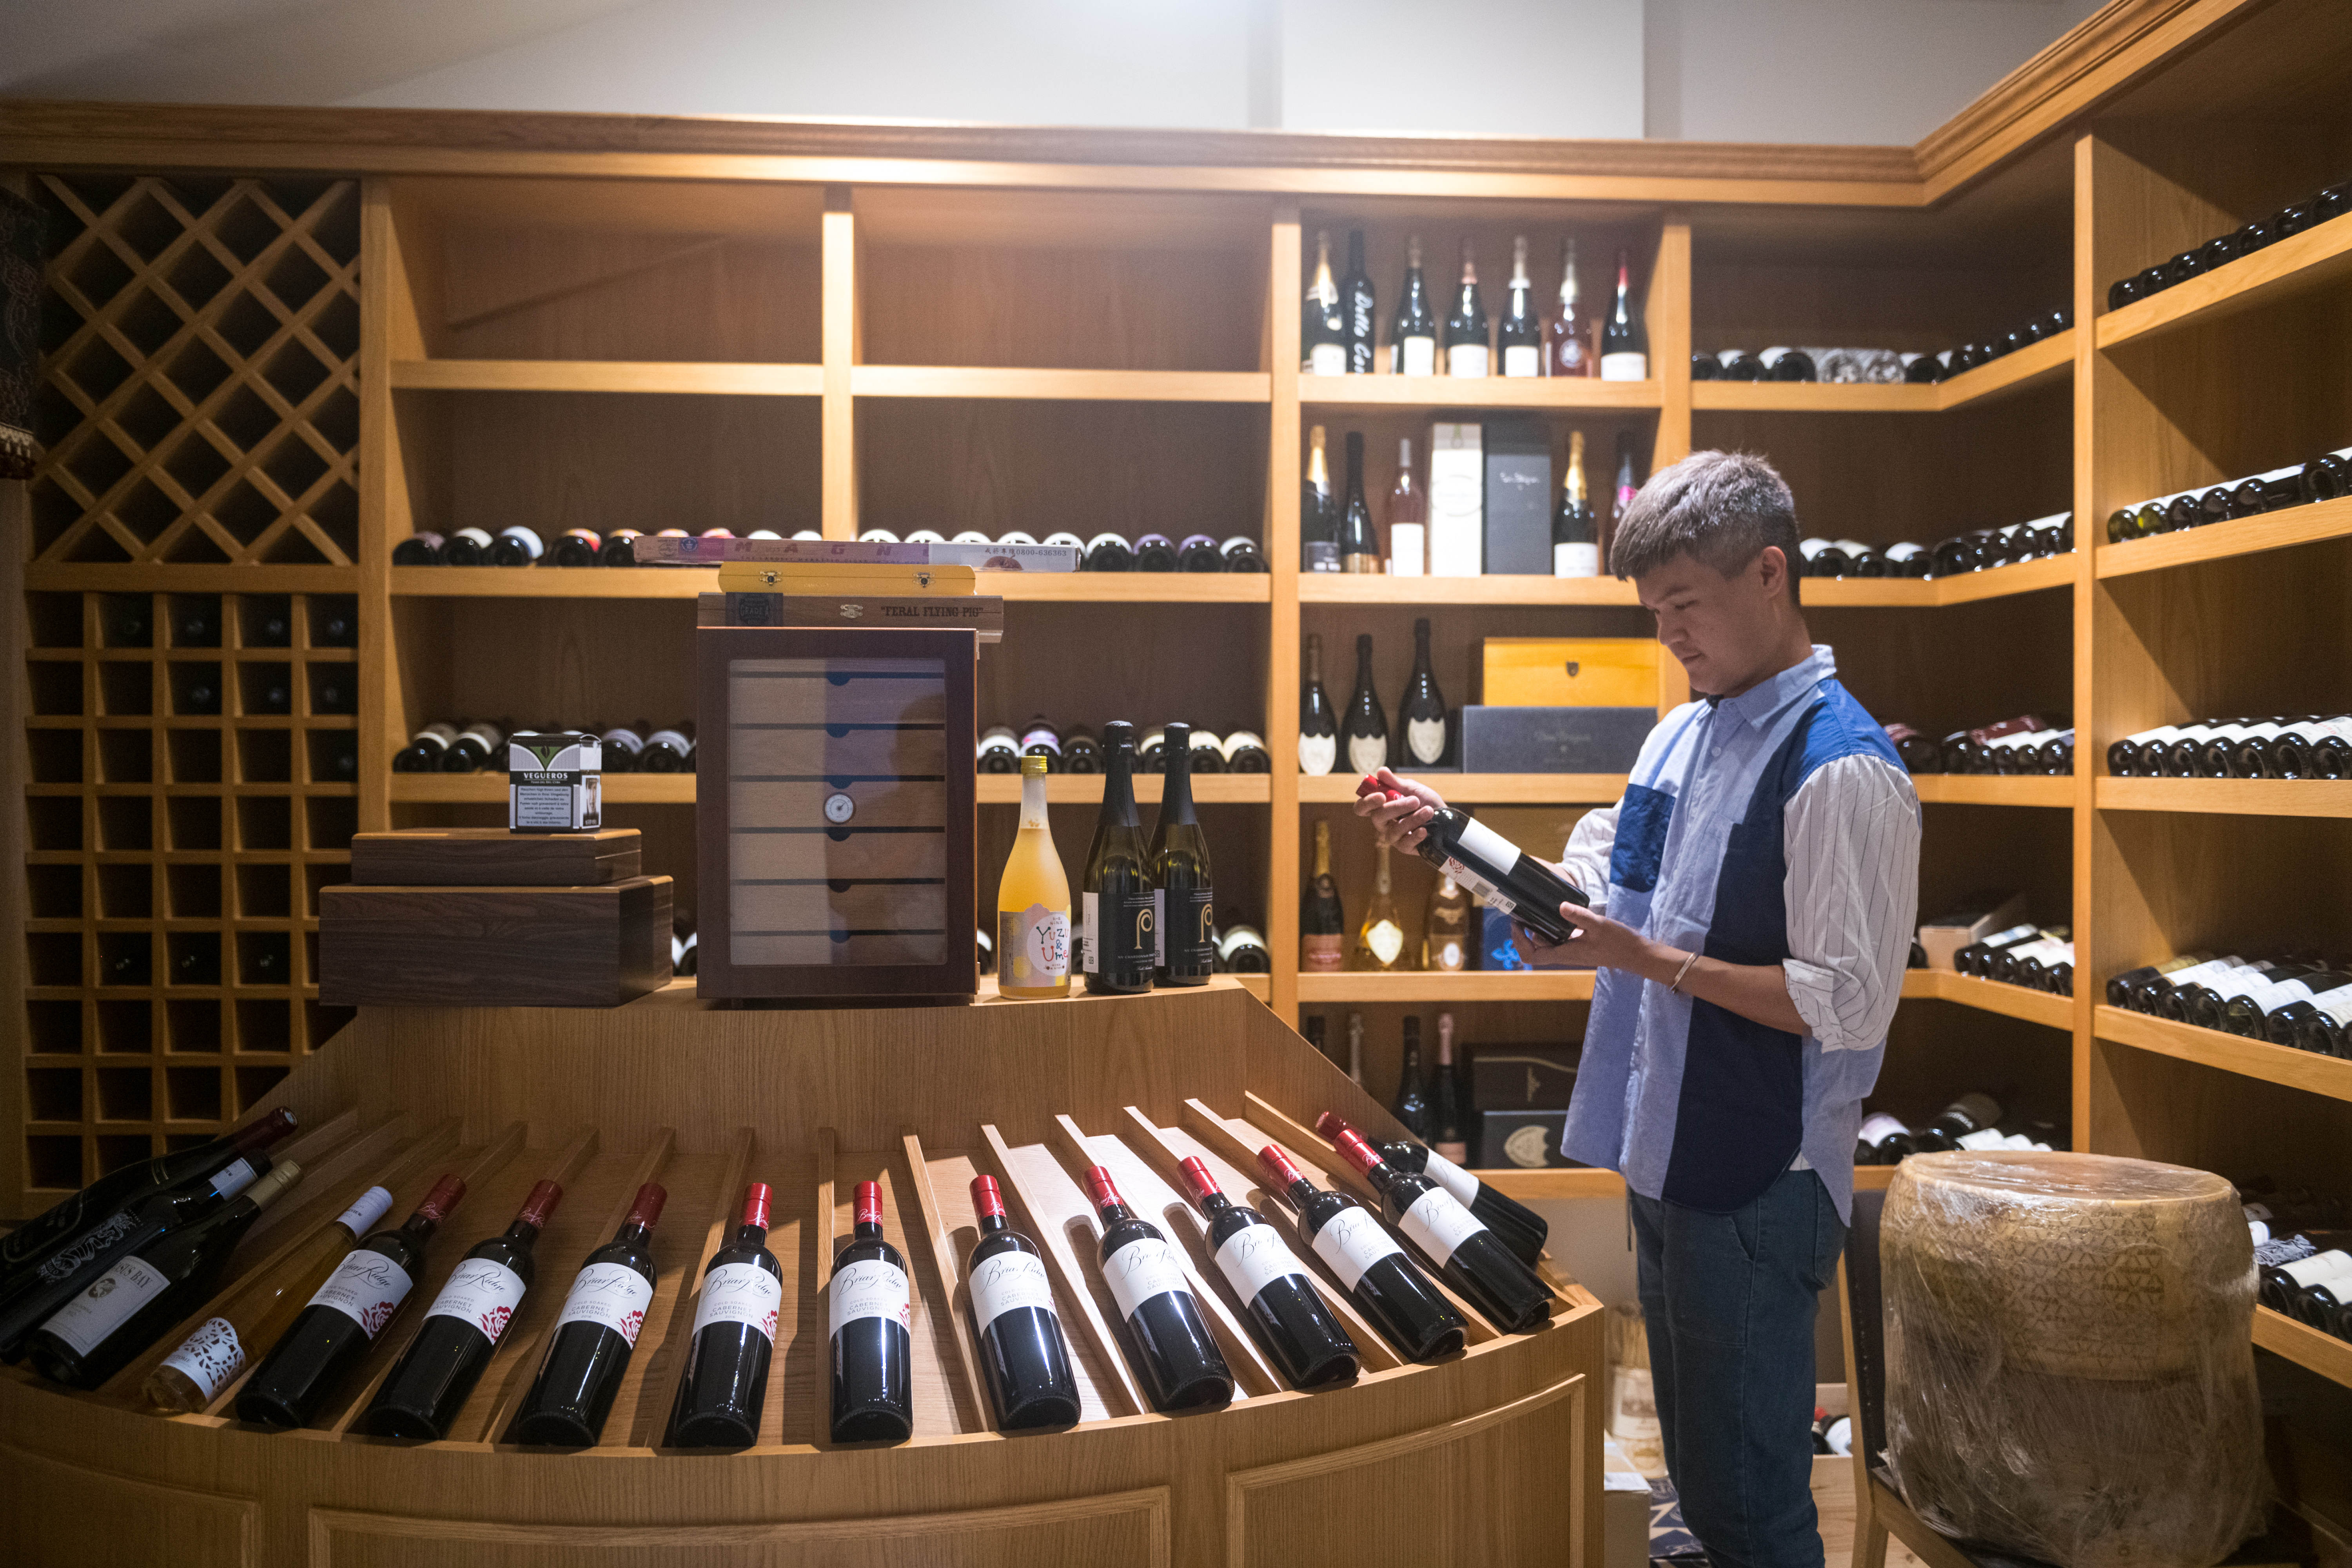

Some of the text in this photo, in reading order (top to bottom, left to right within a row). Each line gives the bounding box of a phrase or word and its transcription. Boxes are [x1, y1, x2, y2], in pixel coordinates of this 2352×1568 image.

[923, 607, 959, 617] FLYING
[1056, 939, 1062, 951] &
[341, 1259, 392, 1288] Ridge
[130, 1270, 153, 1289] BAY
[455, 1265, 506, 1293] Ridge
[573, 1269, 610, 1294] Briar
[702, 1269, 746, 1301] Briar
[833, 1267, 877, 1303] Briar
[321, 1290, 355, 1301] CABERNET
[339, 1286, 358, 1296] SOAKED
[316, 1294, 354, 1307] SAUVIGNON
[1001, 1296, 1043, 1306] SAUVIGNON
[1002, 1292, 1039, 1301] CABERNET
[436, 1299, 473, 1308] CABERNET
[849, 1302, 887, 1310] CABERNET
[432, 1305, 472, 1314] SAUVIGNON
[568, 1310, 611, 1318] SAUVIGNON
[710, 1310, 753, 1318] SAUVIGNON
[847, 1306, 890, 1316] SAUVIGNON
